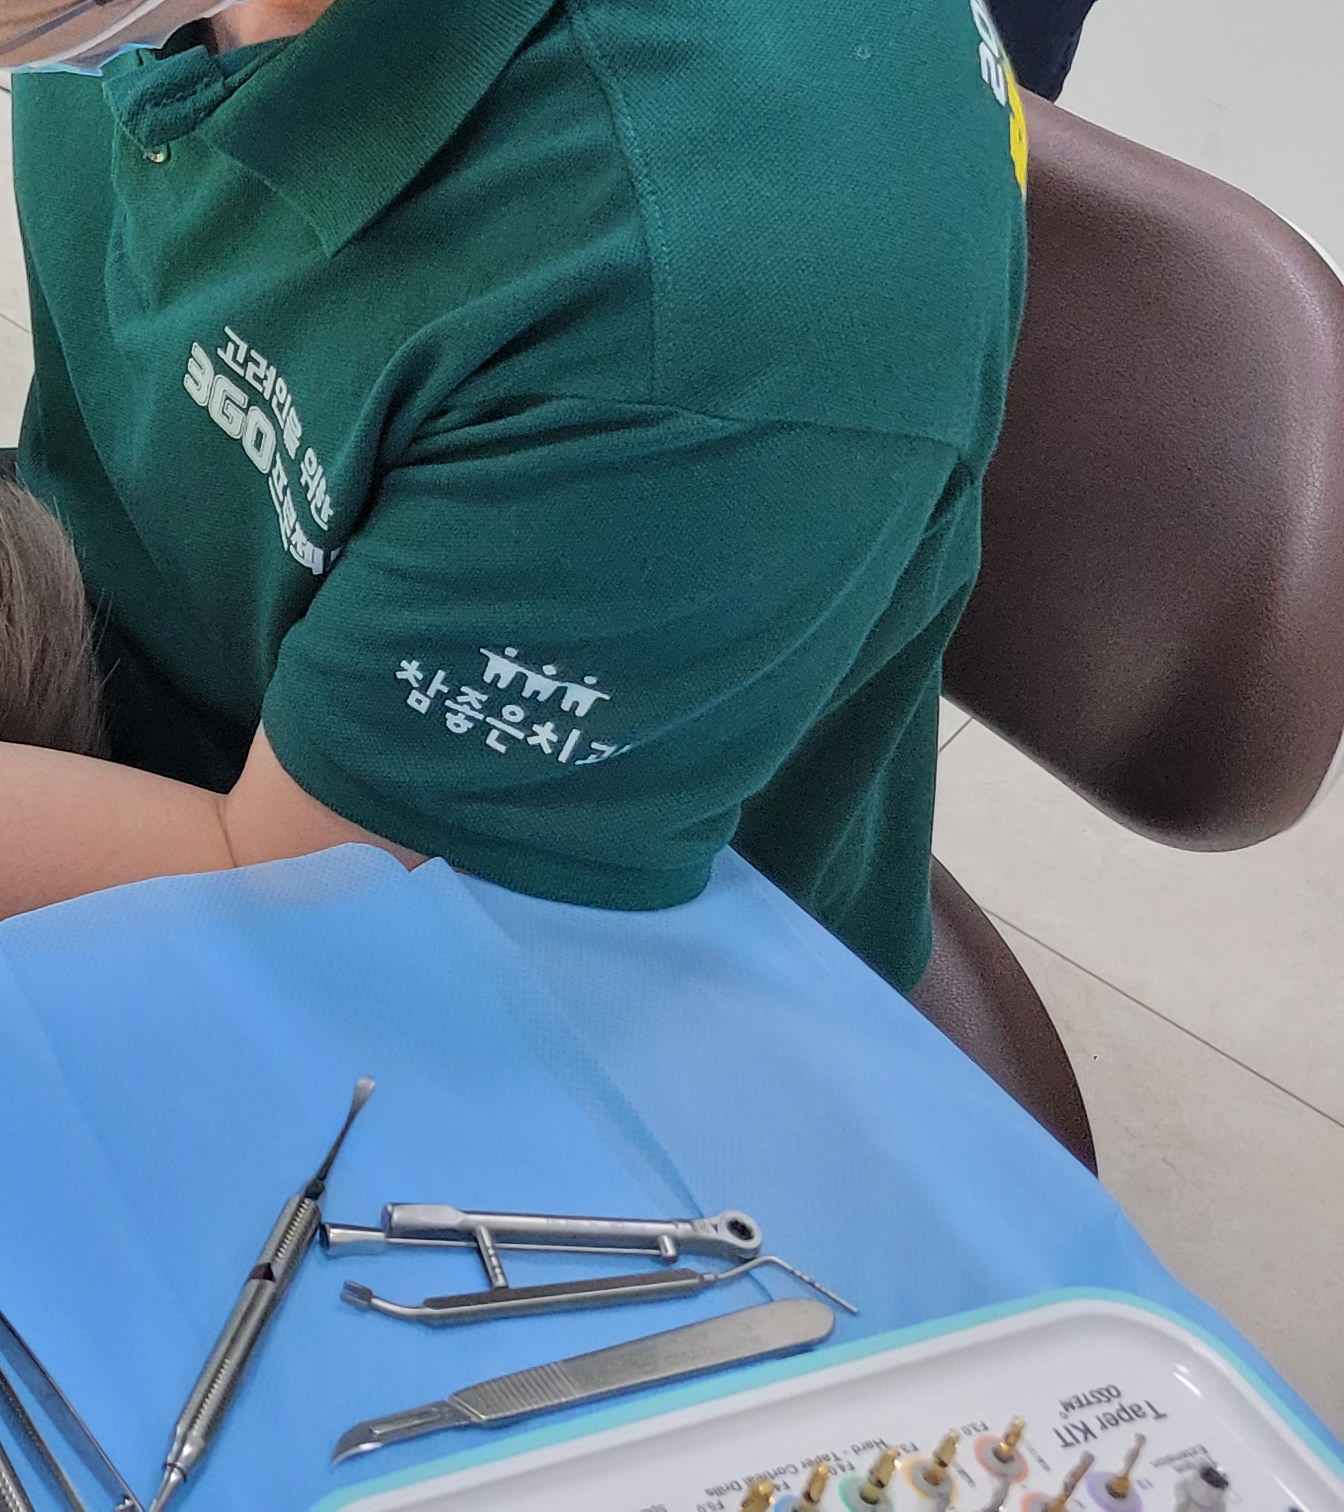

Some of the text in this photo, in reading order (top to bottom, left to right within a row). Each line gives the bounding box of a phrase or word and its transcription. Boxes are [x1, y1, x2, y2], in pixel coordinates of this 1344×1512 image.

[216, 325, 335, 531] 고려인을 위한
[851, 1438, 888, 1455] Hard
[1053, 1399, 1168, 1448] Taper KIT
